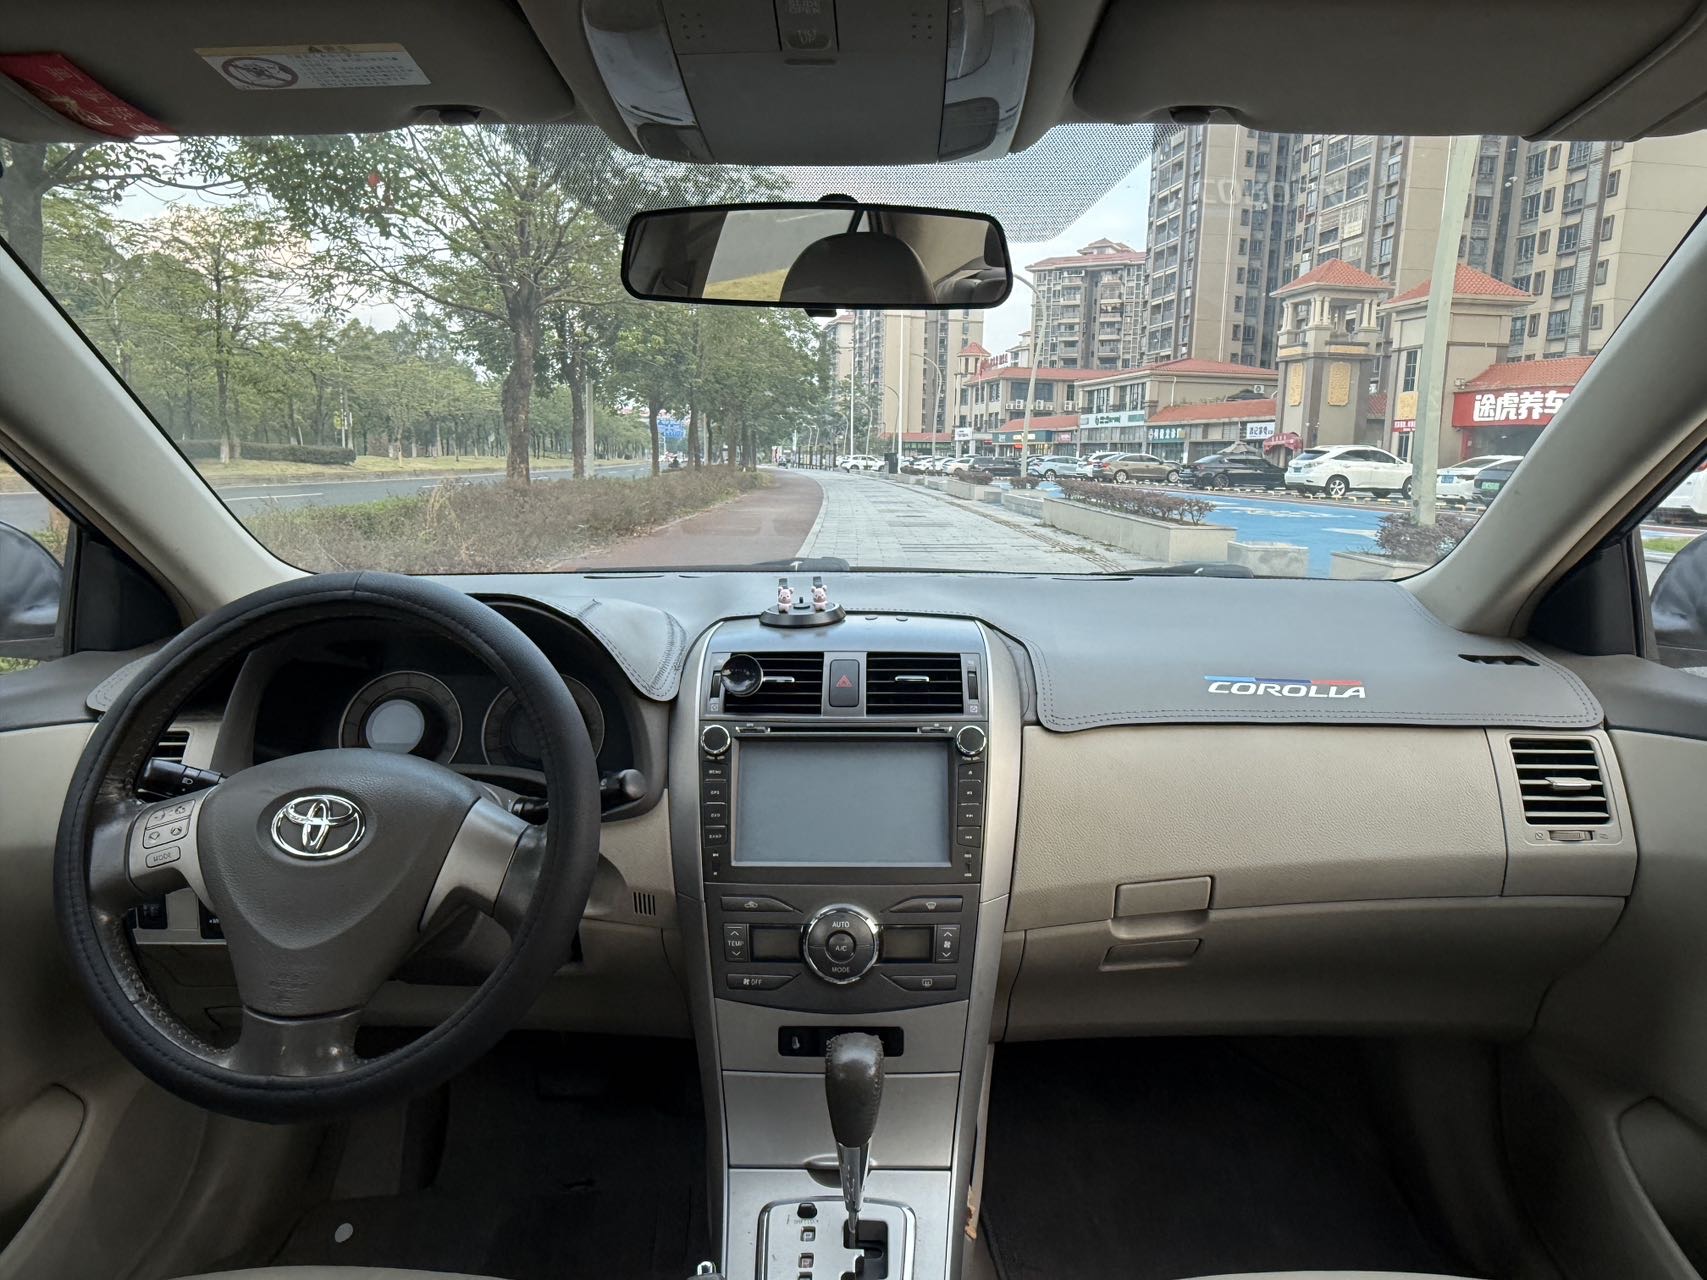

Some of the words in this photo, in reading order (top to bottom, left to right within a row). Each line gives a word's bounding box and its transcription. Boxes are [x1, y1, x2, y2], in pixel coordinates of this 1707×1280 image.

[1473, 390, 1571, 422] 途虎养车
[1208, 682, 1366, 698] COROLLA
[153, 852, 172, 862] MODE
[832, 920, 850, 928] AUTO
[835, 944, 848, 952] A/C
[832, 966, 850, 974] MODE
